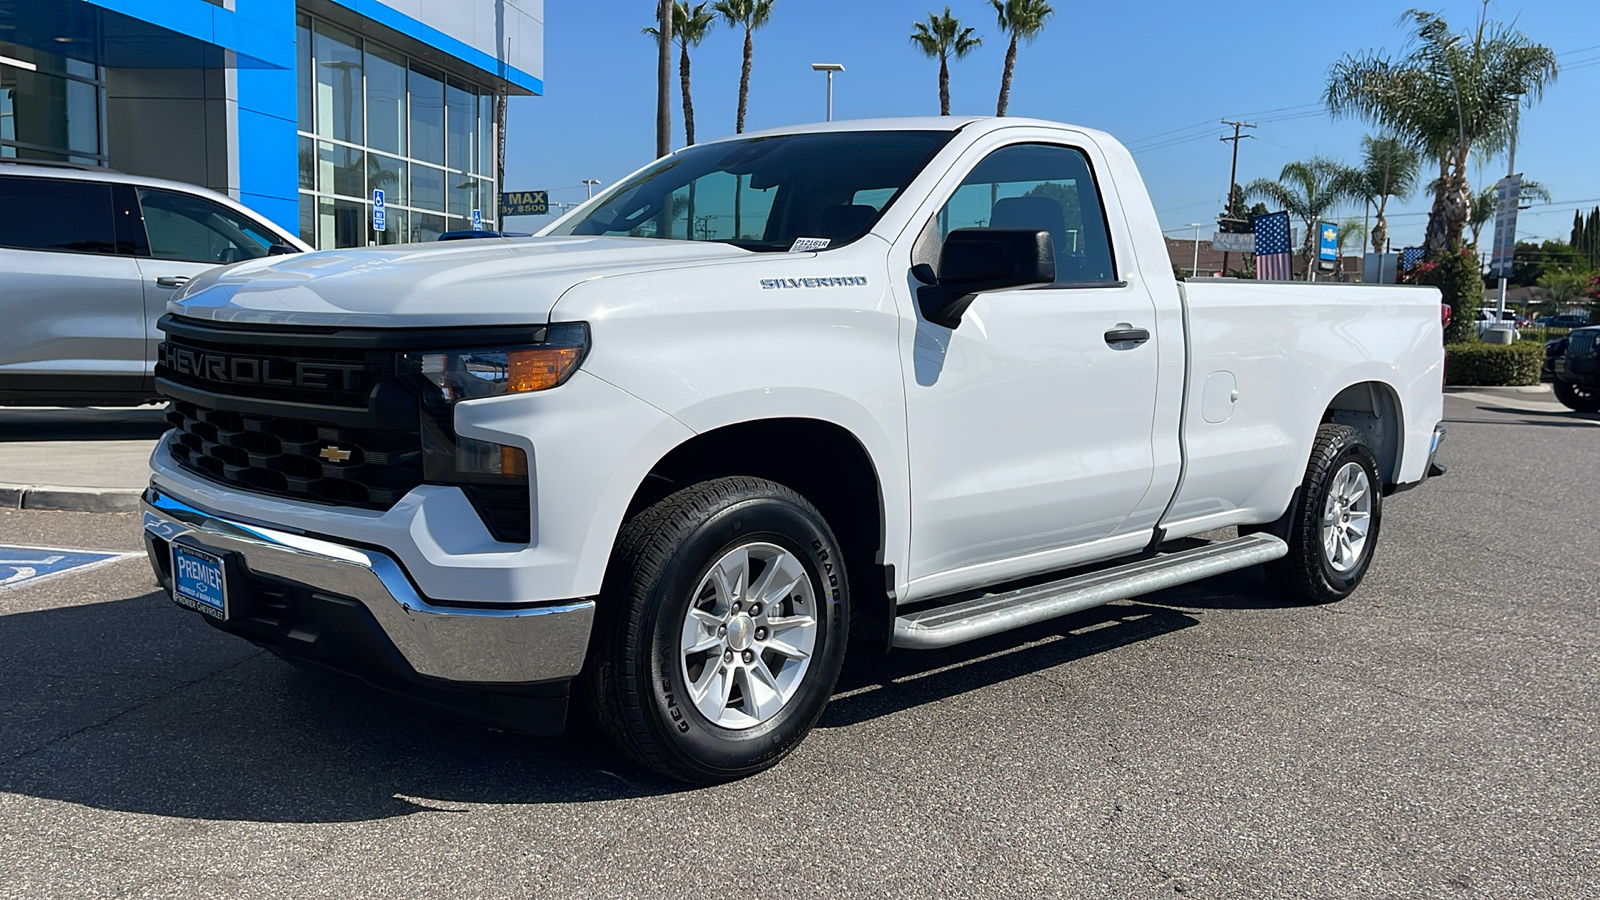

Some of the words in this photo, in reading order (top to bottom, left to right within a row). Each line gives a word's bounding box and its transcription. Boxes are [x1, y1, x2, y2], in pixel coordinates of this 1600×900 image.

[508, 192, 545, 204] MAX
[517, 204, 546, 212] $500
[795, 239, 828, 247] P12161R
[760, 276, 867, 289] SILVERADO
[177, 556, 223, 591] PREMIER
[175, 593, 197, 609] PREMIER
[197, 602, 223, 620] CHEVROLET
[660, 634, 690, 734] GENERA
